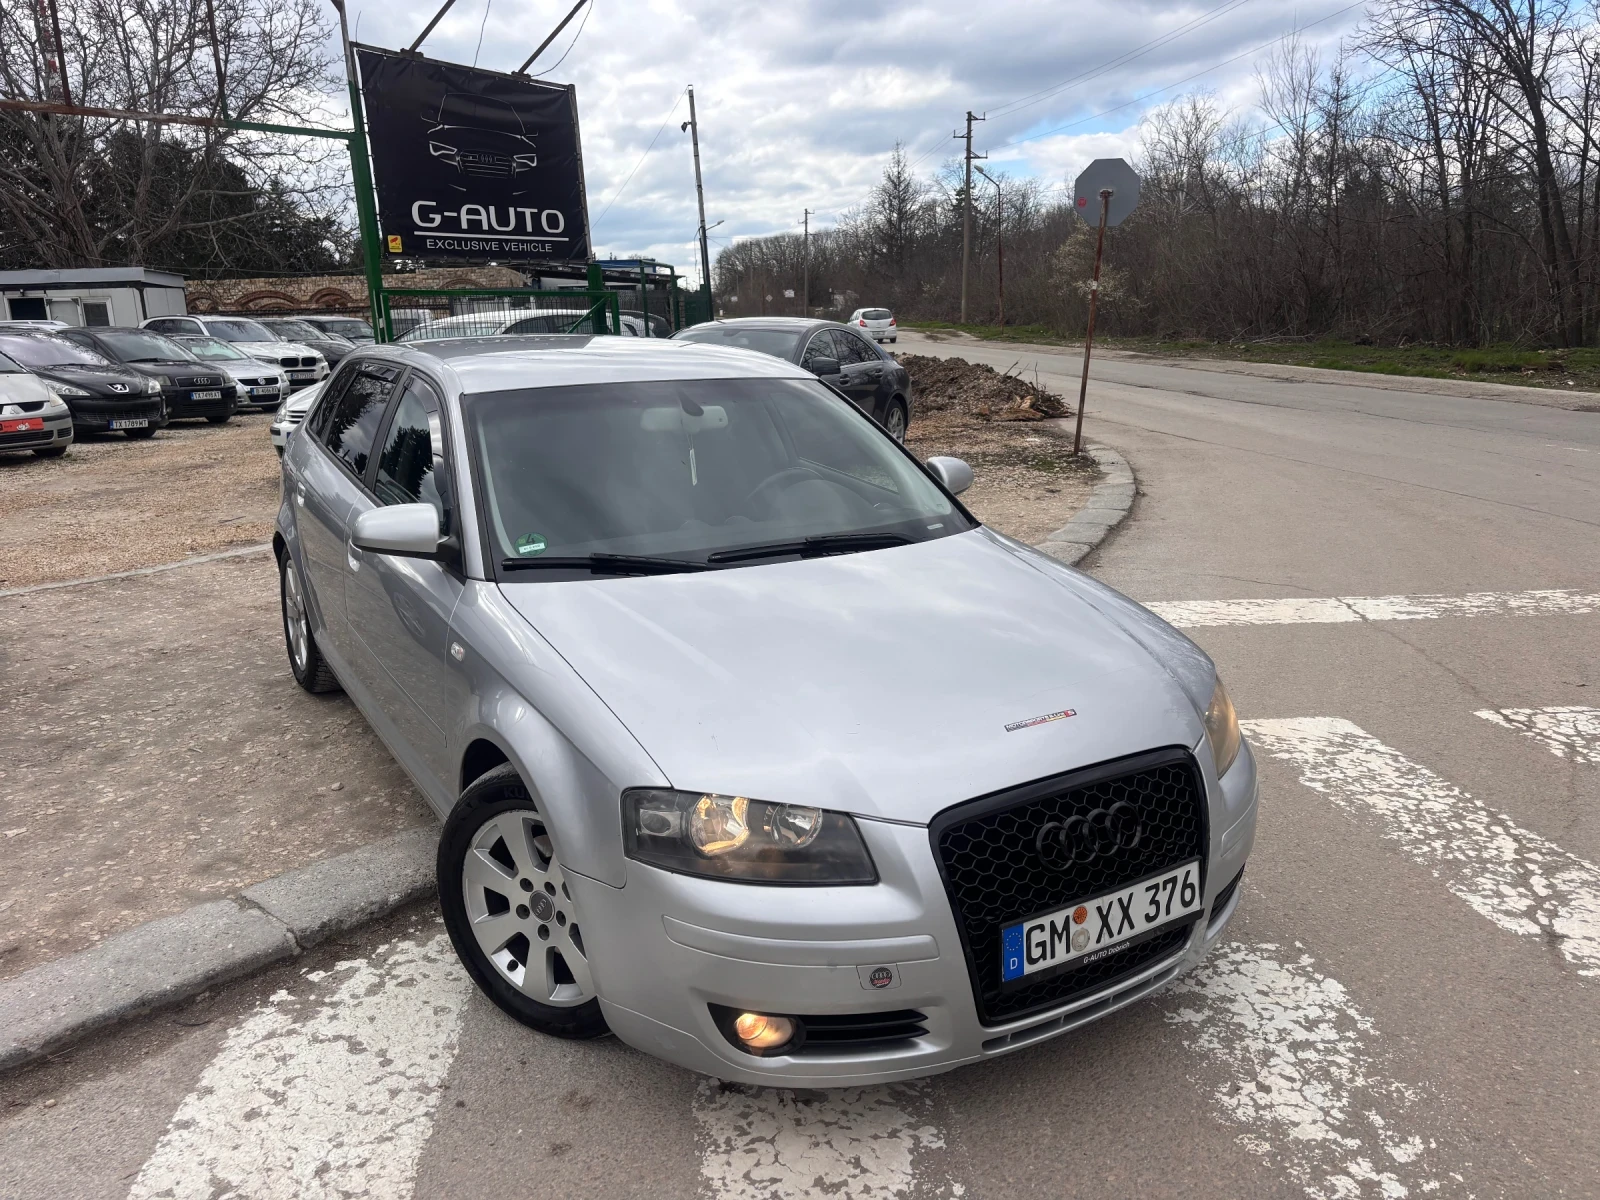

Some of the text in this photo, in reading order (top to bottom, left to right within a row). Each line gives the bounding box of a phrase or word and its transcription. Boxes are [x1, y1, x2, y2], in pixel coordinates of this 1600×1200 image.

[411, 200, 565, 234] G-AUTO
[426, 238, 553, 253] EXCLUSIVE VEHICLE
[1025, 869, 1196, 966] GM XX 376
[1010, 957, 1018, 970] D
[1083, 941, 1131, 964] G-AUTO Dobrich
